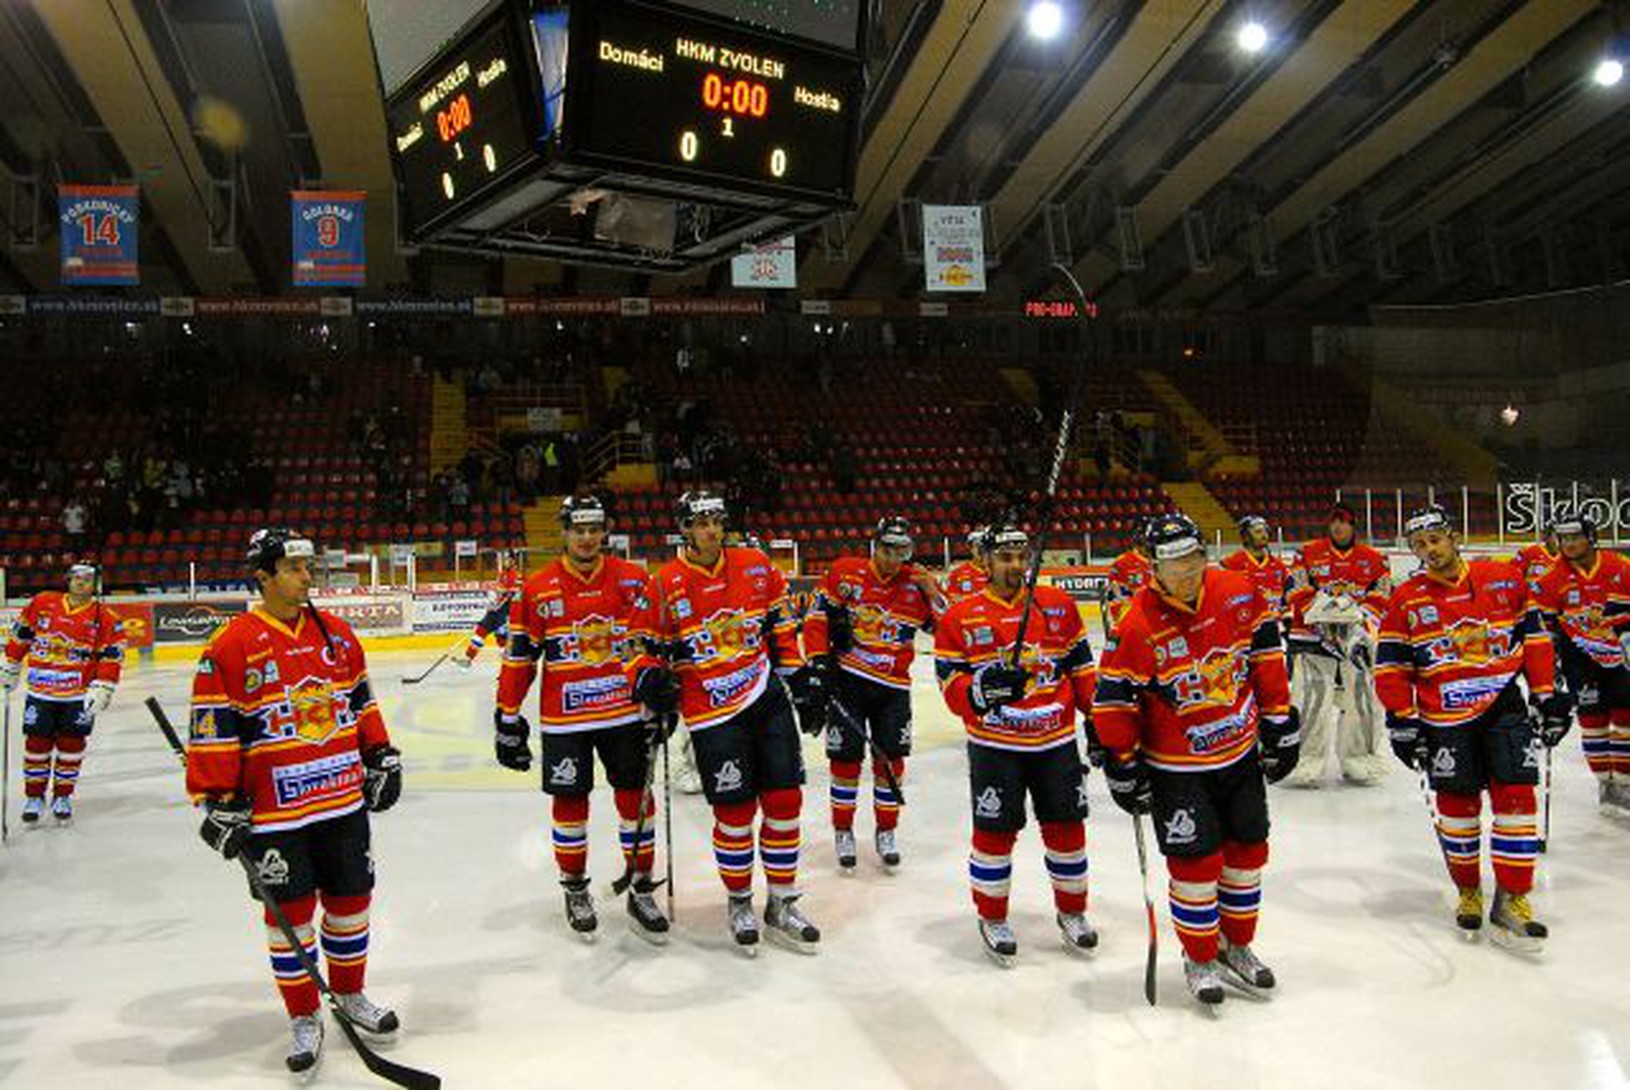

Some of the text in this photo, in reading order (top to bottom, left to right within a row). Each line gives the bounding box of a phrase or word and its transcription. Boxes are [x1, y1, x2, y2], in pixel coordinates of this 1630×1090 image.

[600, 41, 663, 72] Domáci
[676, 38, 785, 80] HKM ZVOLEN
[703, 73, 767, 117] 0:00
[437, 93, 471, 141] 0:00
[722, 117, 734, 137] 1
[442, 143, 496, 199] 0 0
[680, 131, 787, 177] 0 0
[80, 212, 121, 246] 14
[318, 216, 340, 247] 9
